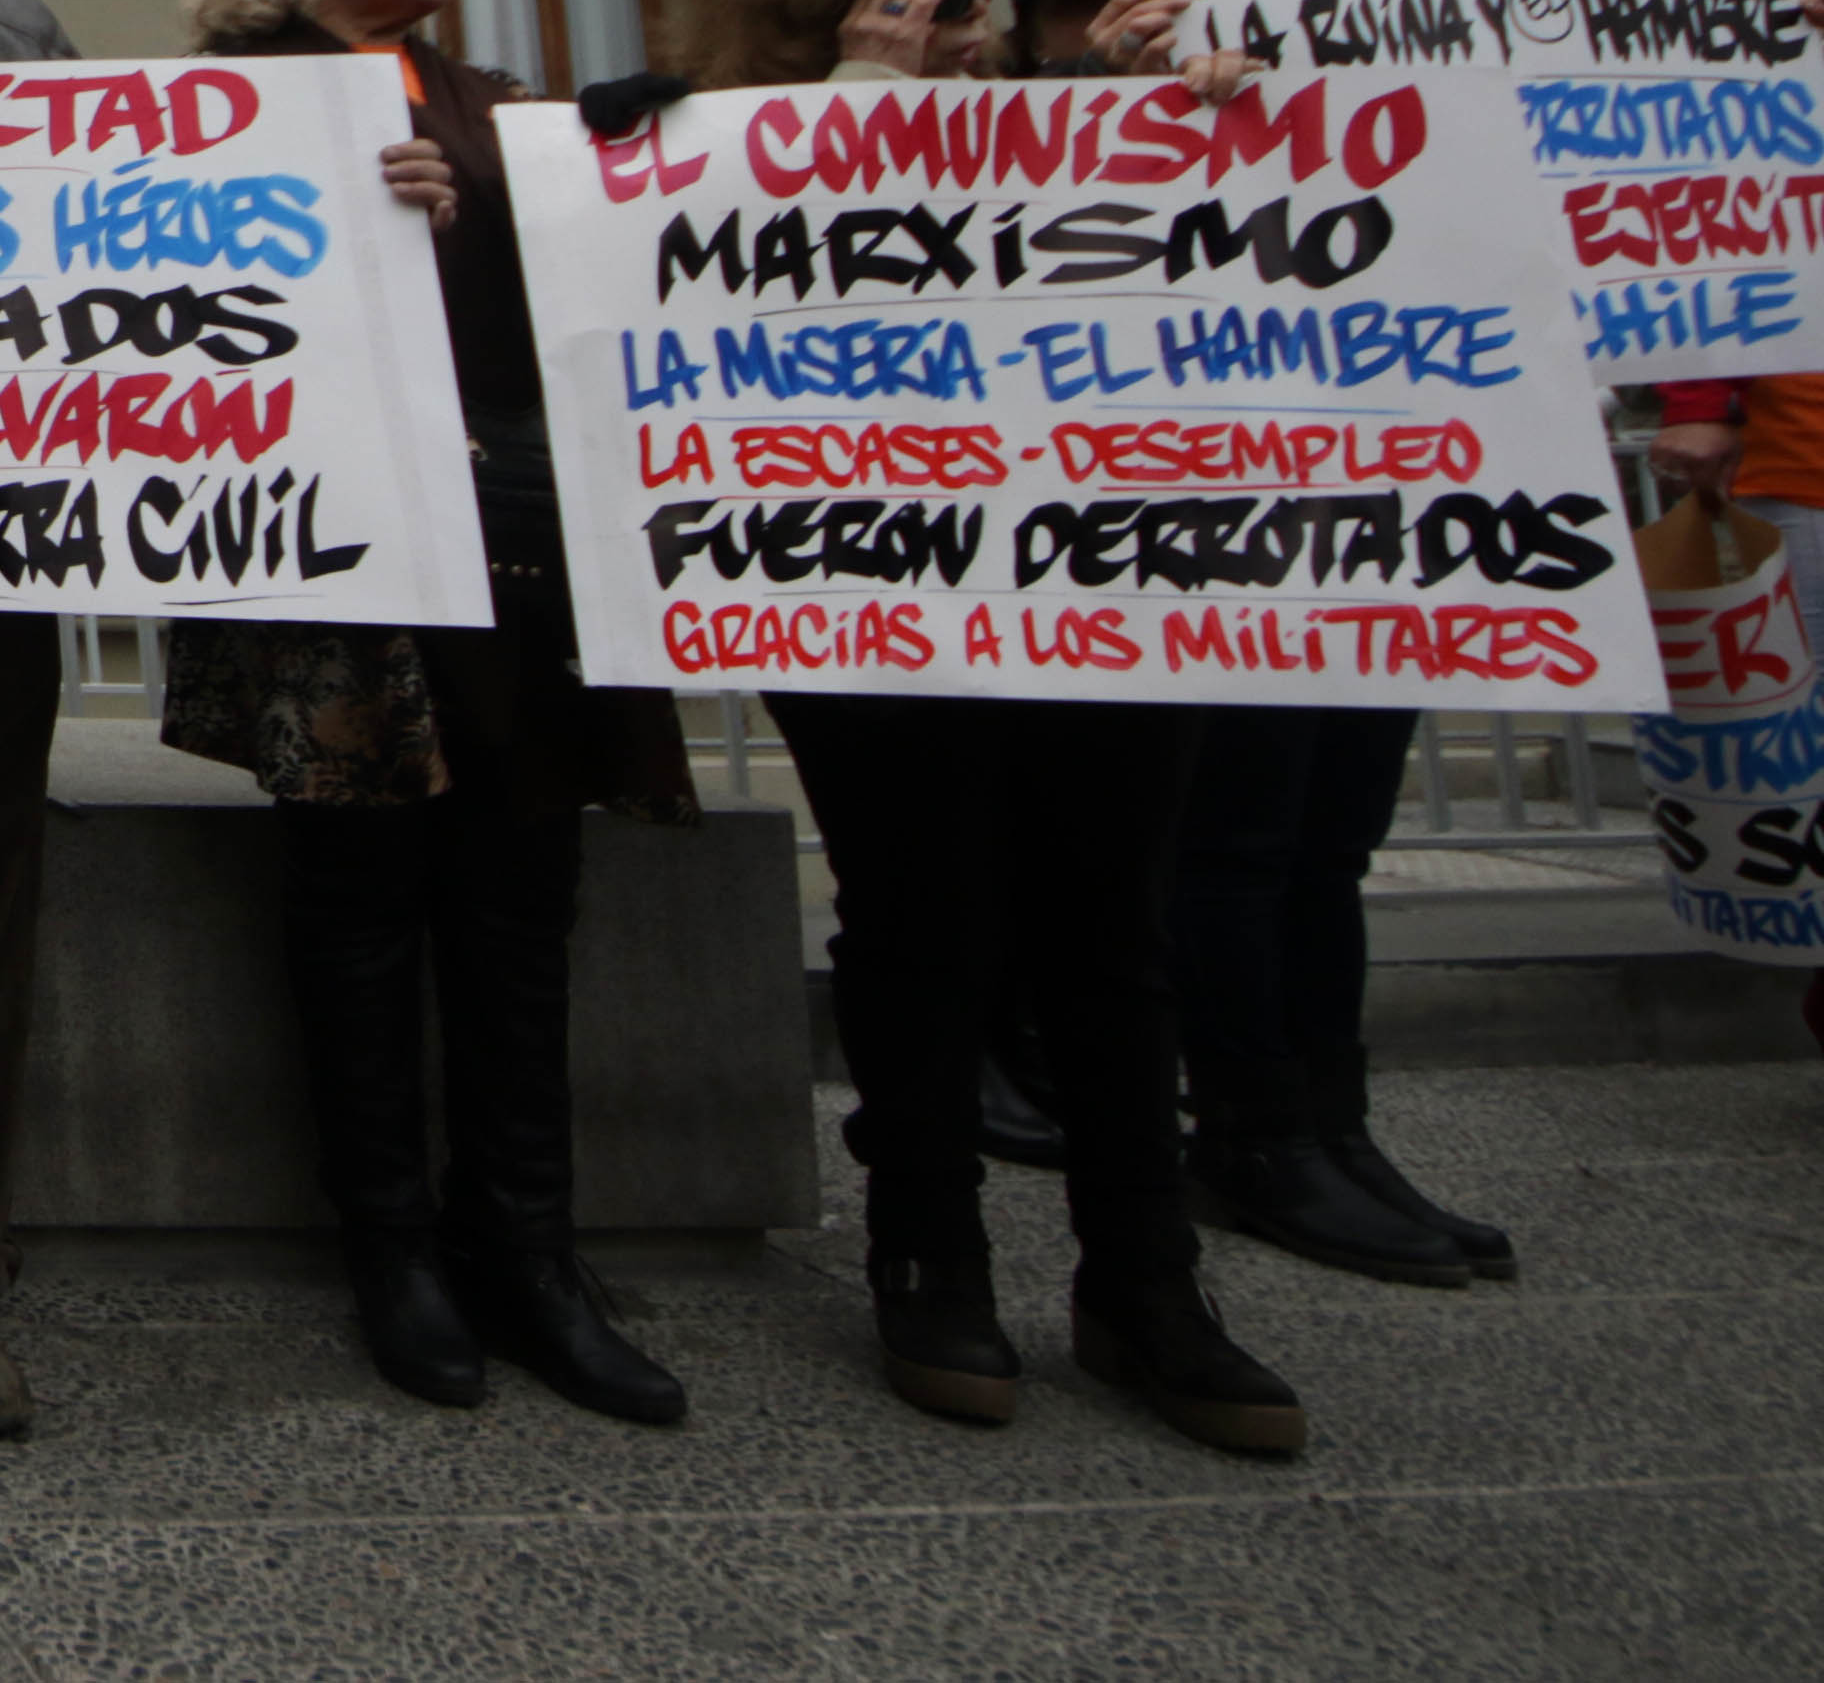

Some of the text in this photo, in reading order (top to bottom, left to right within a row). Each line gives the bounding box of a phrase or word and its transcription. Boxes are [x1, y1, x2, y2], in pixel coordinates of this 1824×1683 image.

[53, 158, 329, 279] HÉROES
[621, 329, 709, 411] LA
[1036, 323, 1154, 398] EL
[1156, 301, 1523, 388] HAMBRE
[638, 423, 715, 489] LA
[731, 424, 1009, 489] ESCASES
[1061, 421, 1483, 487] DESEMPLEO
[1014, 489, 1615, 593] DERROTADOS
[965, 602, 1003, 667] A
[1022, 607, 1142, 673] LOS
